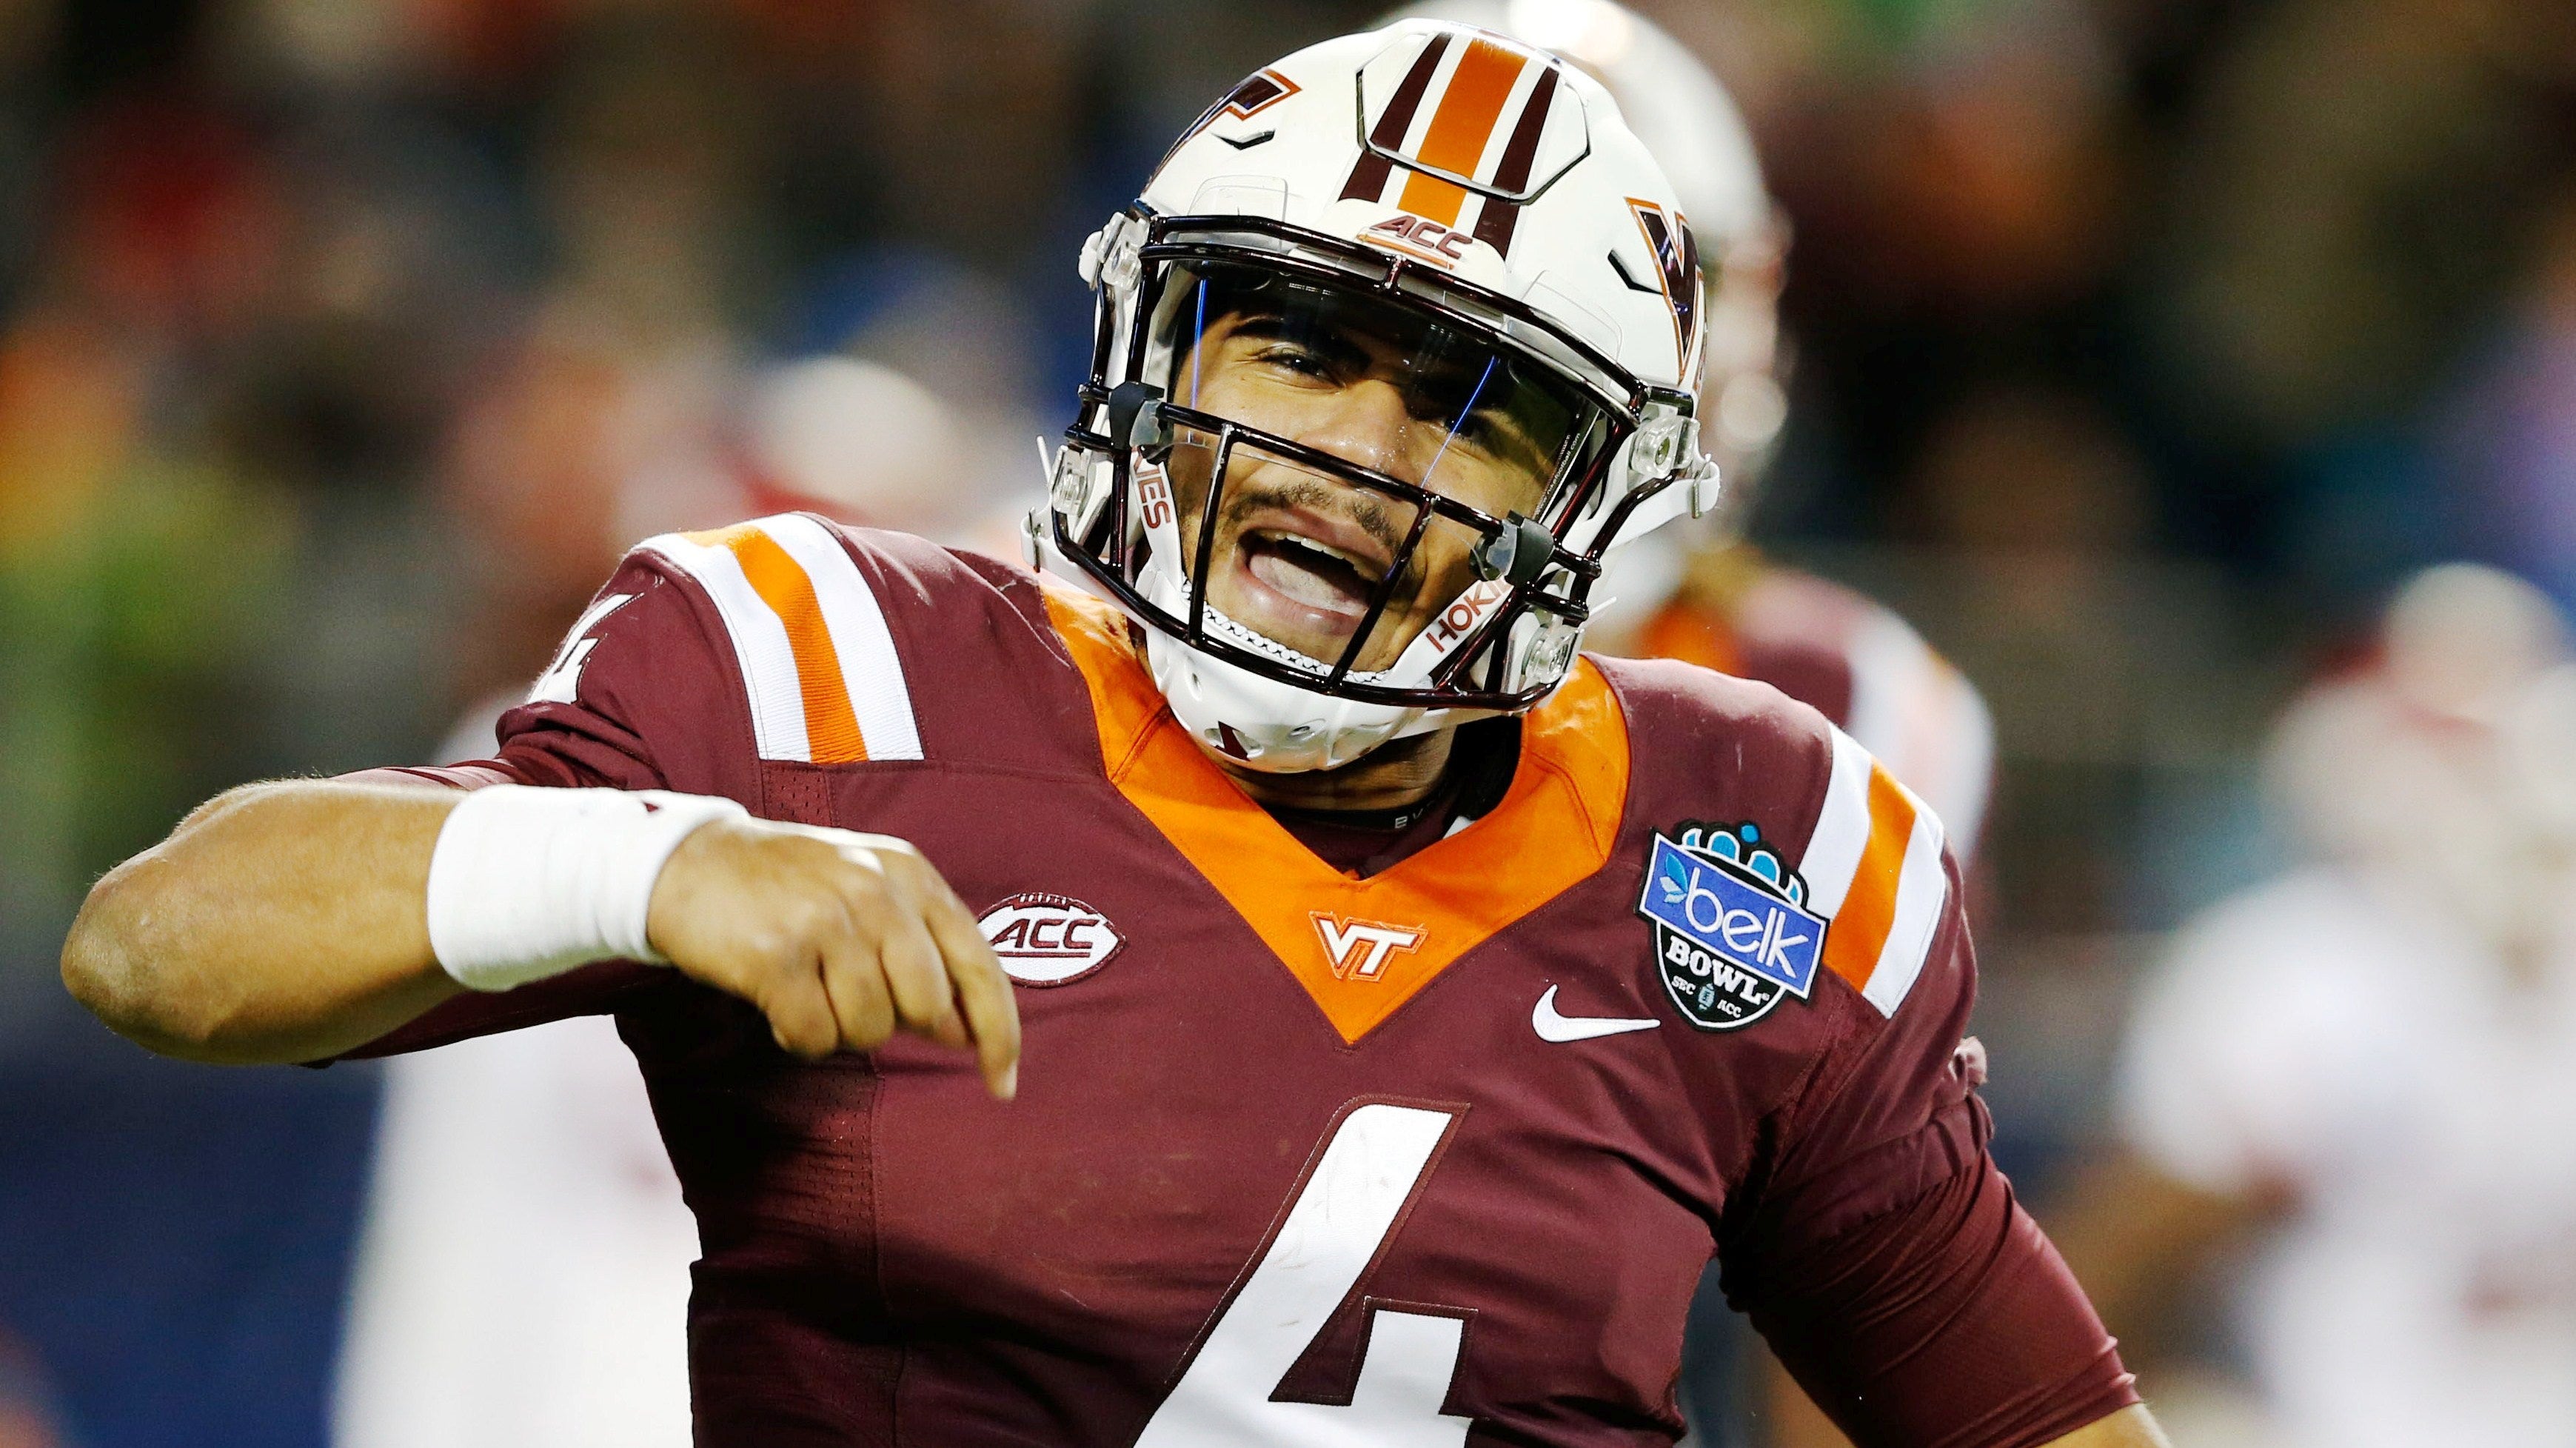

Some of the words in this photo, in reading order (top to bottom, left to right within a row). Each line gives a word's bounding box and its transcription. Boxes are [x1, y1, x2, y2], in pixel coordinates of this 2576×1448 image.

[1369, 215, 1473, 260] ACC
[988, 918, 1100, 950] ACC
[1685, 867, 1810, 978] belk
[1314, 915, 1423, 978] VT
[1671, 975, 1696, 995] SEC
[1717, 999, 1742, 1019] ACC
[1131, 1102, 1474, 1448] 4
